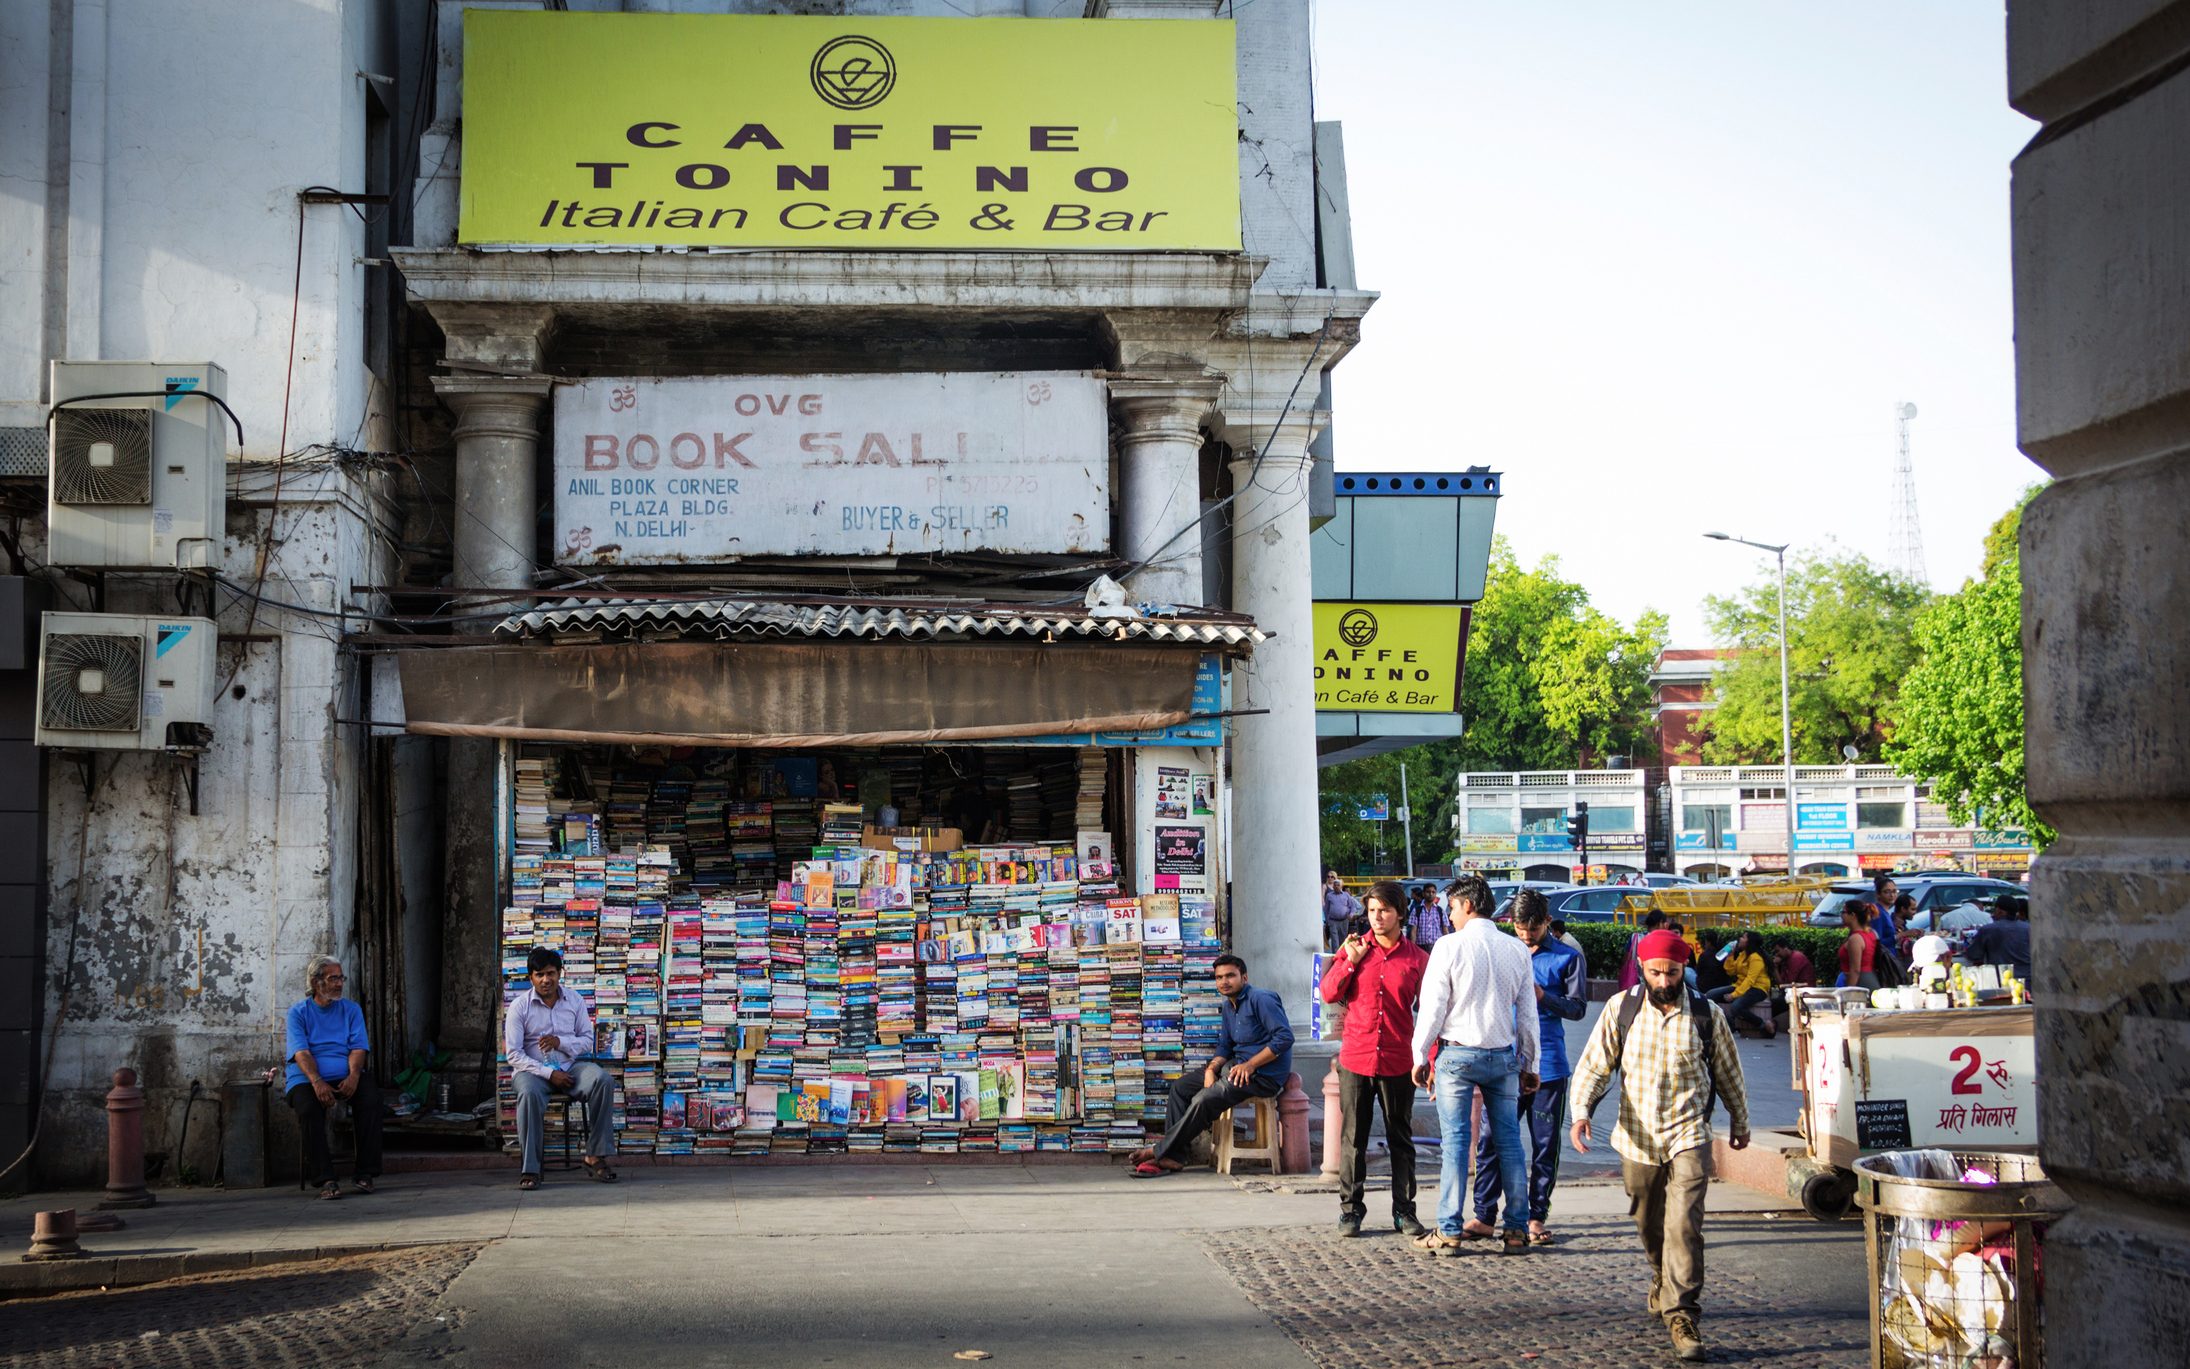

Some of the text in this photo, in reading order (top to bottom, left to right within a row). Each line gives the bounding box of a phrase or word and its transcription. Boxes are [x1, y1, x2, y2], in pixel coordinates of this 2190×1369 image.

[626, 122, 1079, 151] CAFFE
[576, 162, 1129, 192] TONINO
[540, 200, 1169, 232] Italian Café & Bar
[735, 394, 823, 415] OVG
[585, 431, 758, 471] BOOK
[568, 478, 740, 495] ANIL BOOK CORNER
[610, 501, 669, 516] PLAZA
[842, 505, 1009, 531] BUYER & SELLER
[1323, 649, 1417, 663] AFFE
[1196, 673, 1214, 681] UIDES
[1314, 667, 1430, 682] ONINO
[1336, 690, 1379, 704] Café
[1386, 691, 1399, 704] &
[1405, 691, 1439, 705] Bar
[1160, 829, 1200, 838] Audition
[1176, 838, 1186, 847] in
[1167, 847, 1194, 856] Delhi
[1113, 909, 1136, 919] SAT
[1182, 909, 1203, 919] SAT
[1950, 1045, 1982, 1095] 2
[1936, 1102, 2018, 1133] प्रति गिलास
